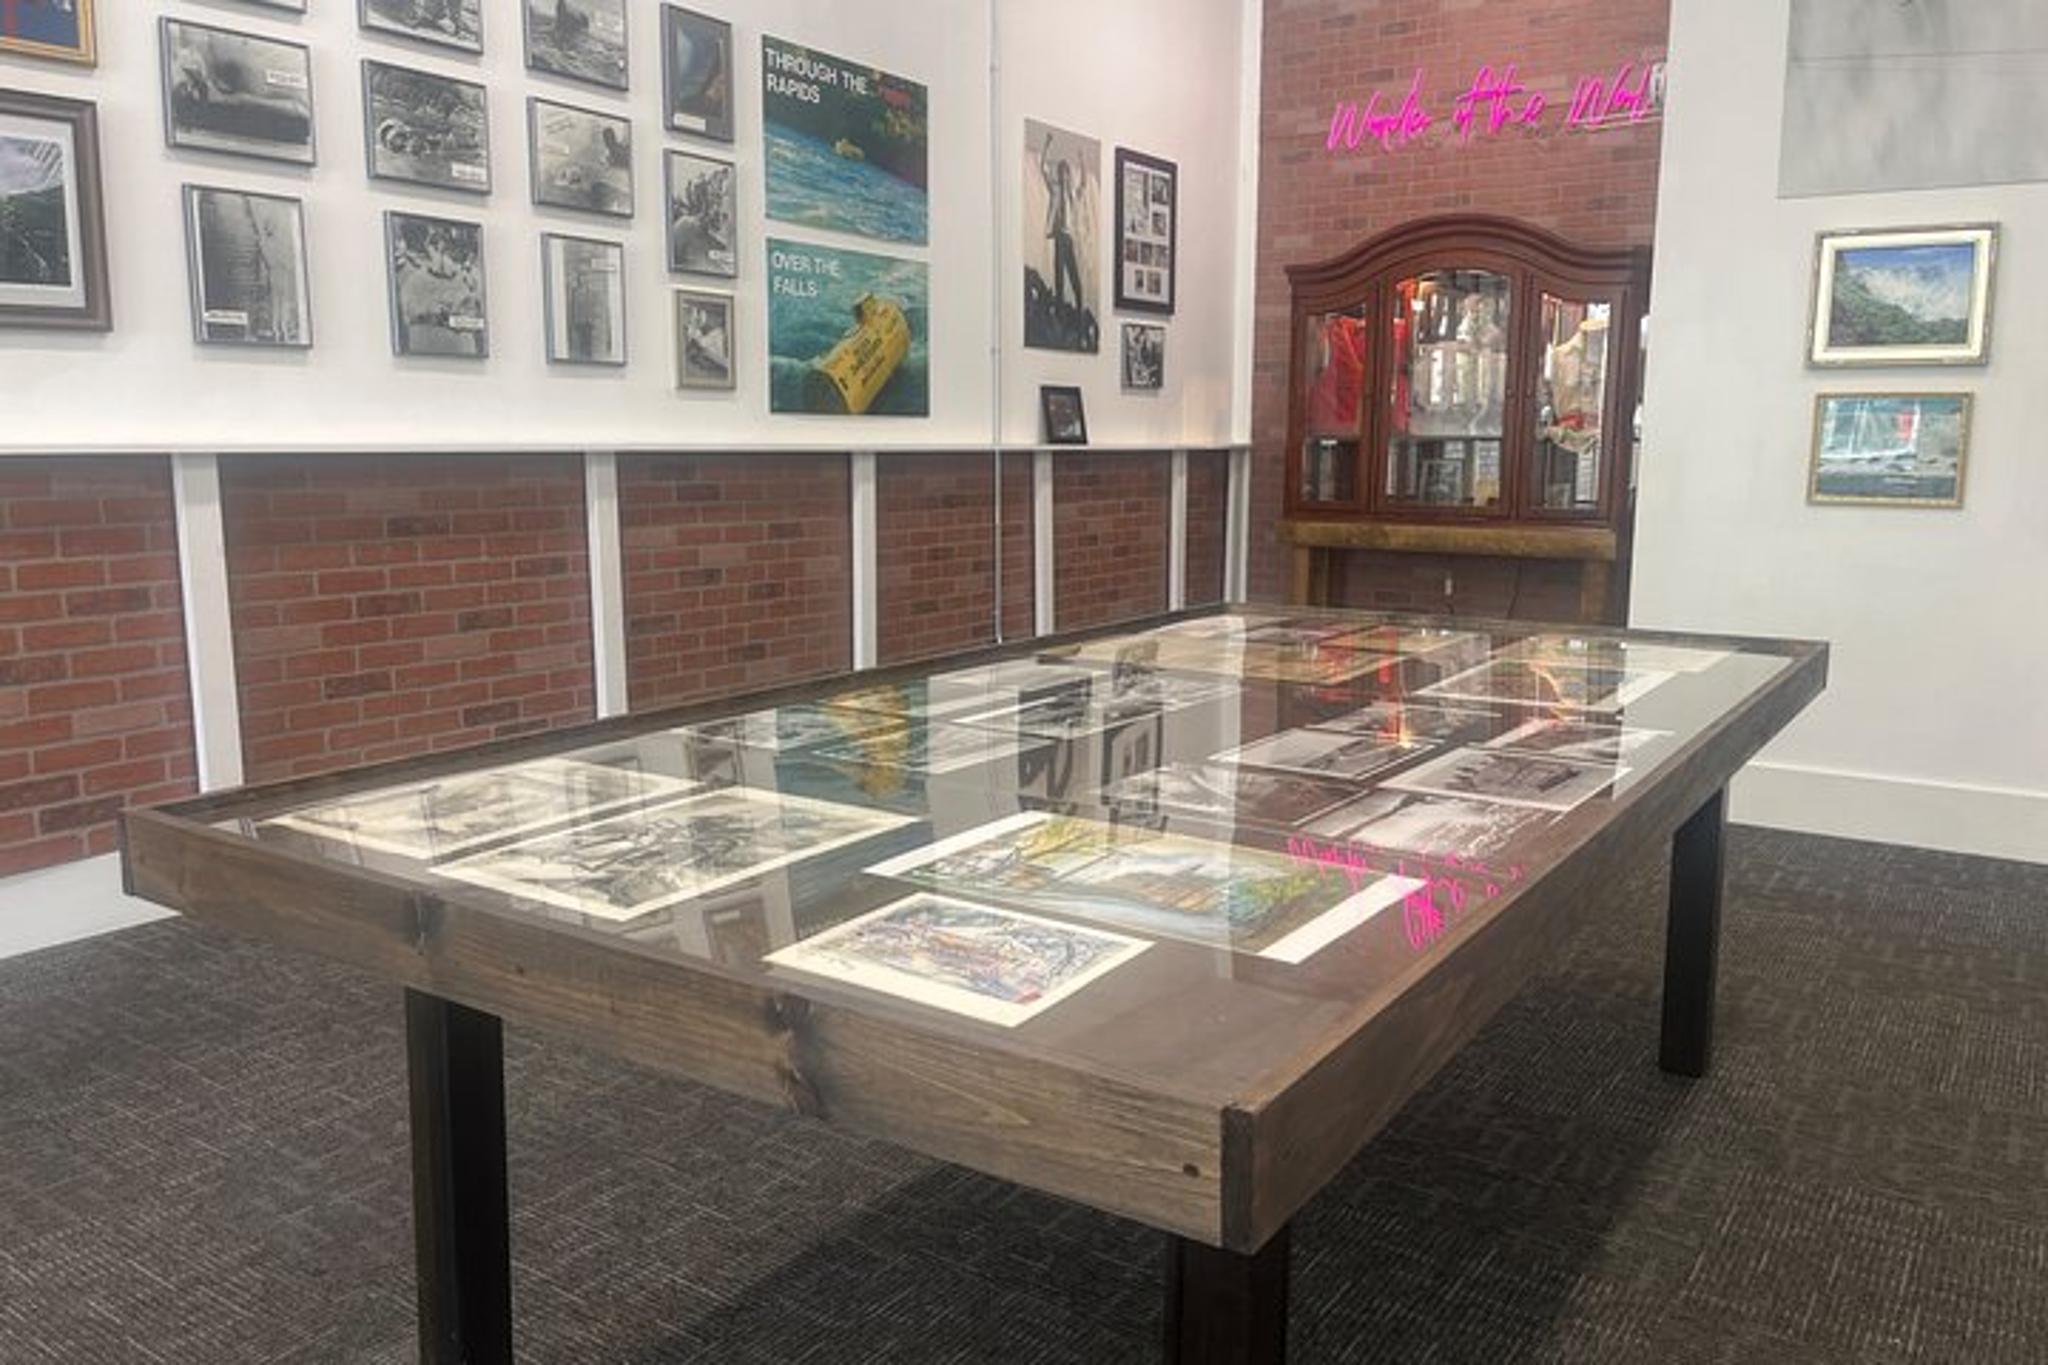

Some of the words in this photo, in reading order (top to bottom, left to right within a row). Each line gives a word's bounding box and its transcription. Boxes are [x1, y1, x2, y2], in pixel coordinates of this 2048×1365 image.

[765, 48, 837, 85] THROUGH
[841, 70, 868, 95] THE
[767, 73, 820, 103] RAPIDS
[772, 250, 812, 273] OVER
[814, 257, 841, 277] THE
[773, 275, 818, 298] FALLS
